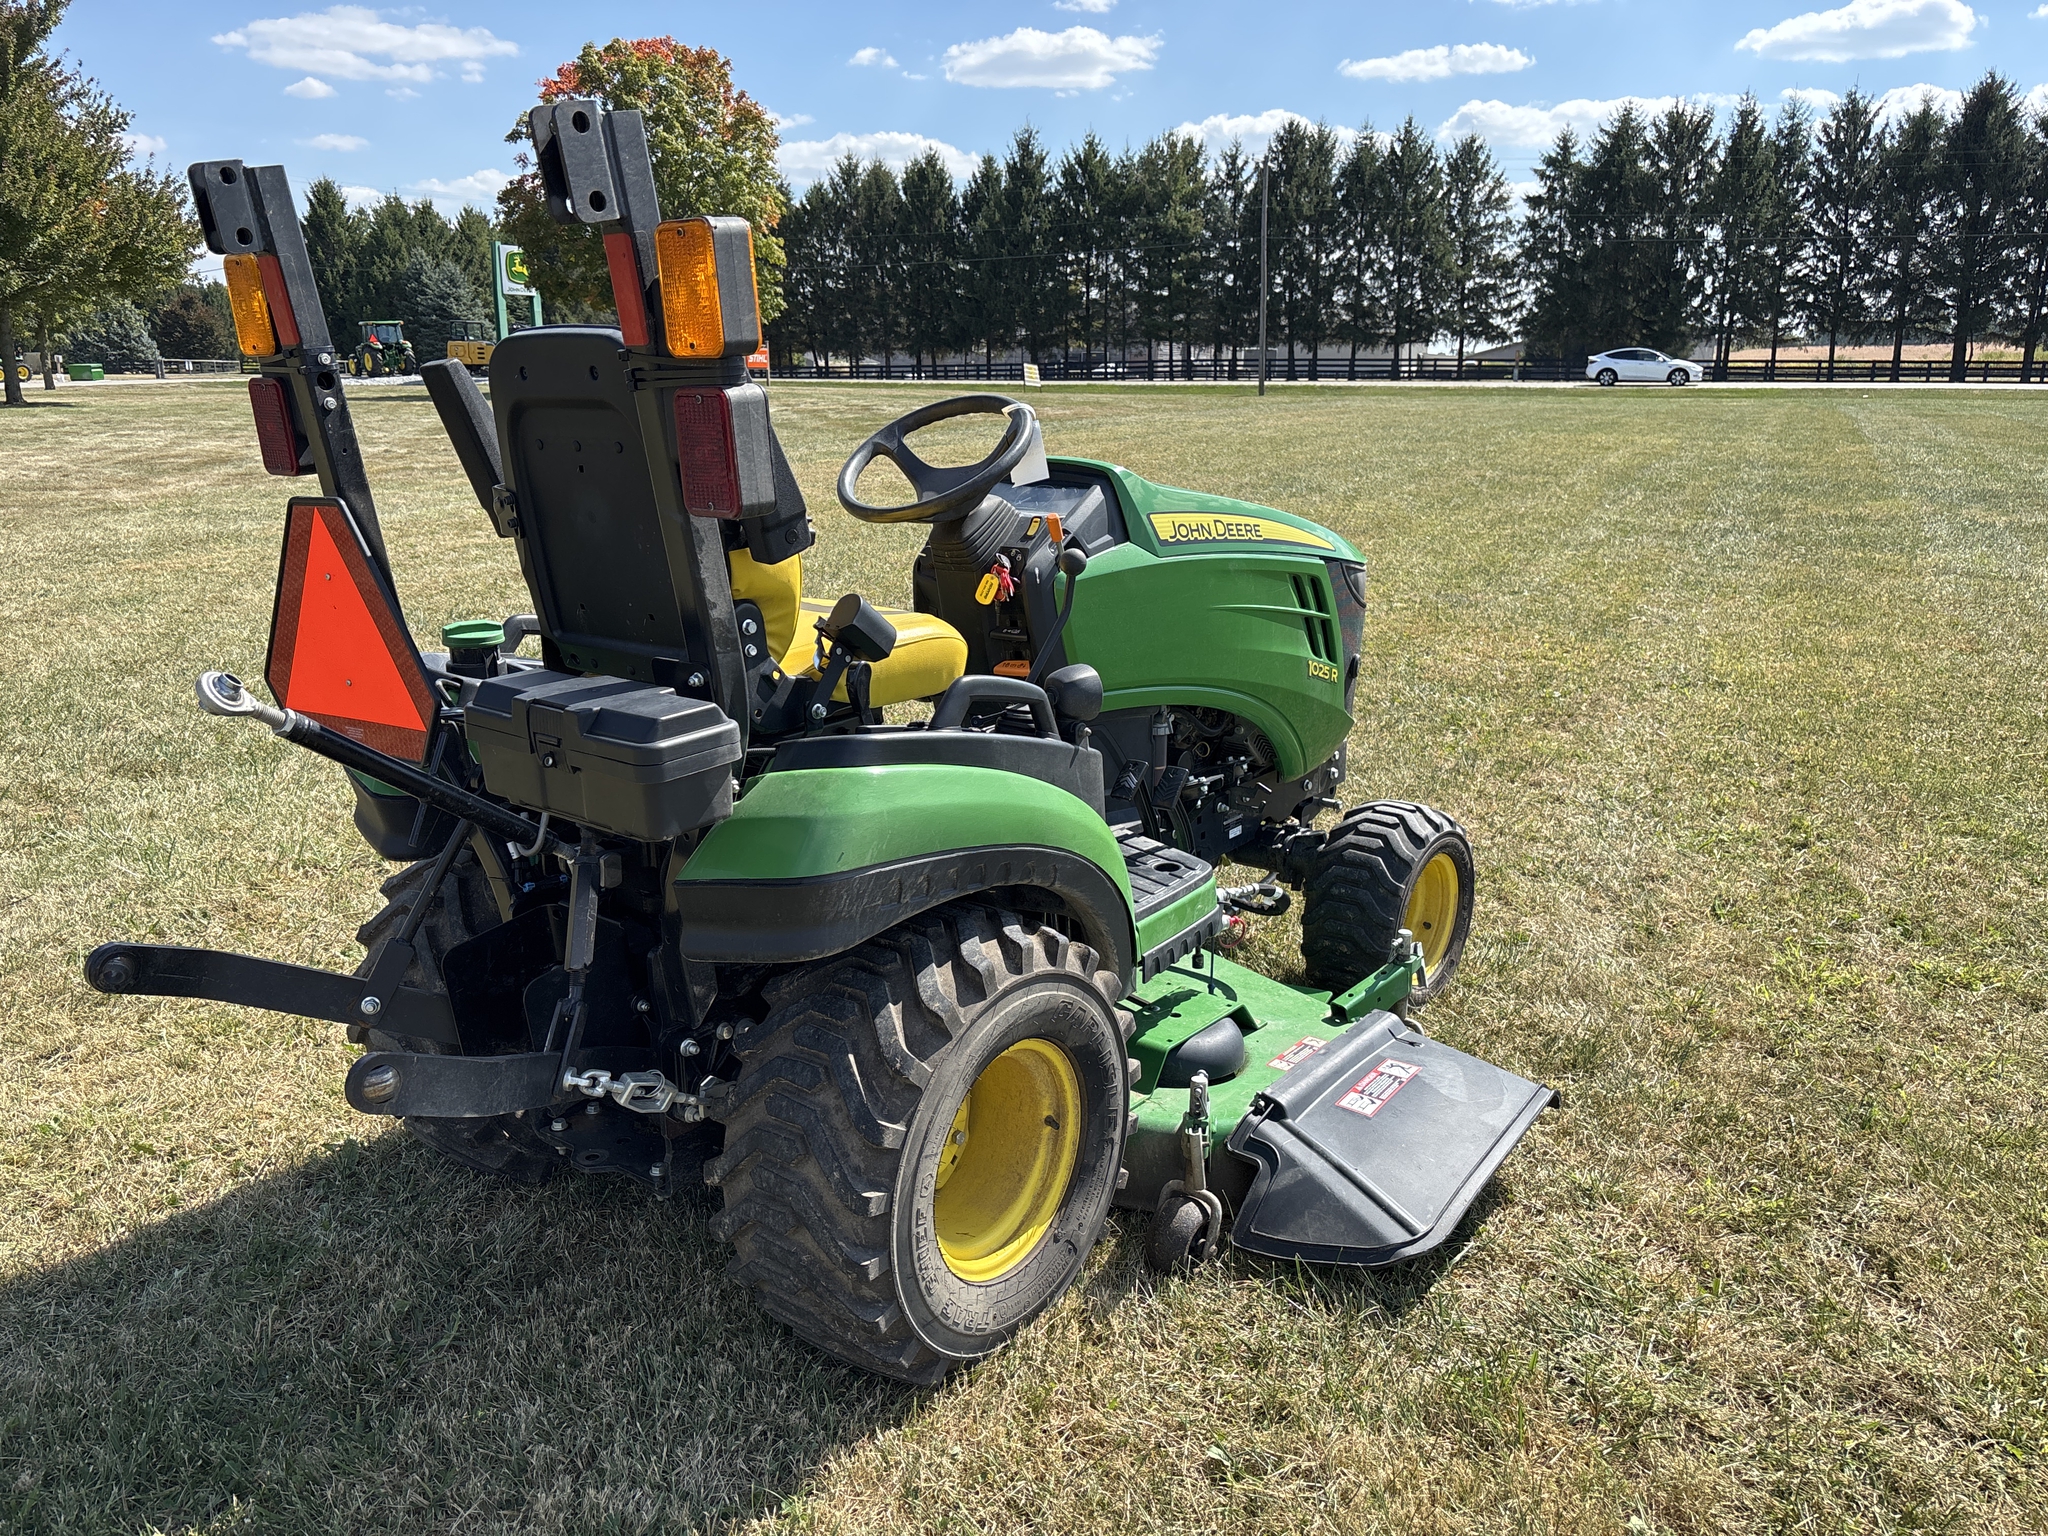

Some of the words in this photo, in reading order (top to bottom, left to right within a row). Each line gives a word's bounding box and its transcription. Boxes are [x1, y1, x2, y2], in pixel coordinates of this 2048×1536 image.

[749, 354, 768, 363] STIHL
[1169, 520, 1212, 540] JOHN
[1213, 519, 1263, 538] DEERE
[1308, 660, 1330, 680] 1025
[1331, 668, 1338, 683] R
[1051, 999, 1119, 1132] CARLISLE
[941, 1299, 993, 1332] TRAC
